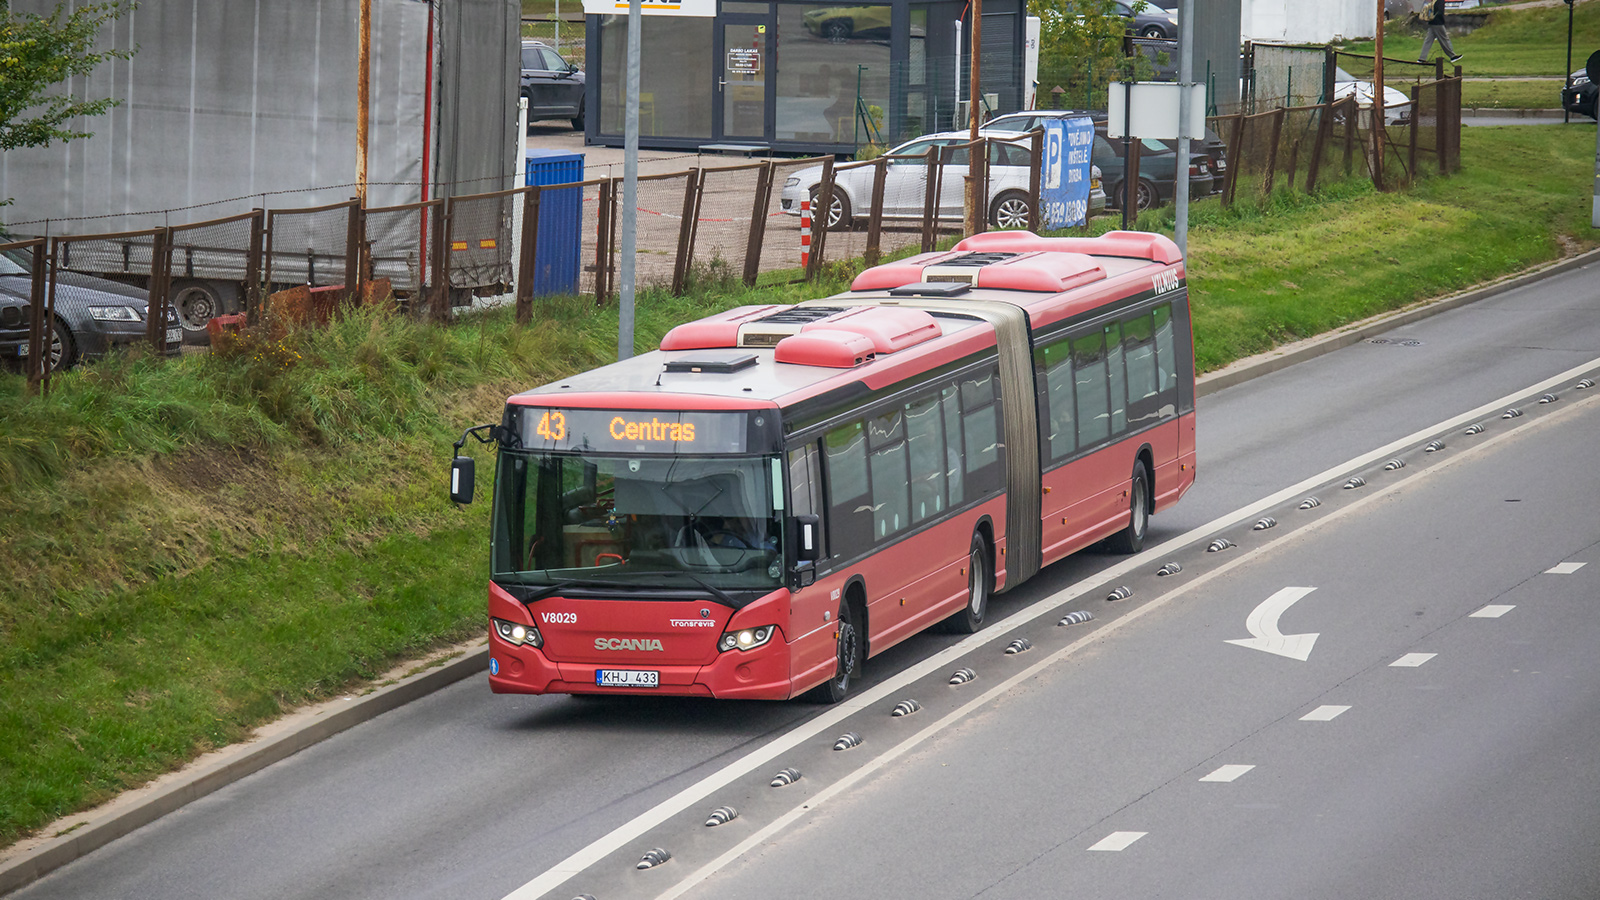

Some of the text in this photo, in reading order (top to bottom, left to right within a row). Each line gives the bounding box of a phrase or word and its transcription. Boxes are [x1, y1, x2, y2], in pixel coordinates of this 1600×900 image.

[1152, 268, 1179, 295] VILNIUS
[537, 412, 695, 442] 43 Centras
[541, 612, 577, 624] V8029
[594, 637, 664, 652] SCANIA
[603, 671, 628, 683] KHJ
[636, 672, 657, 683] 433
